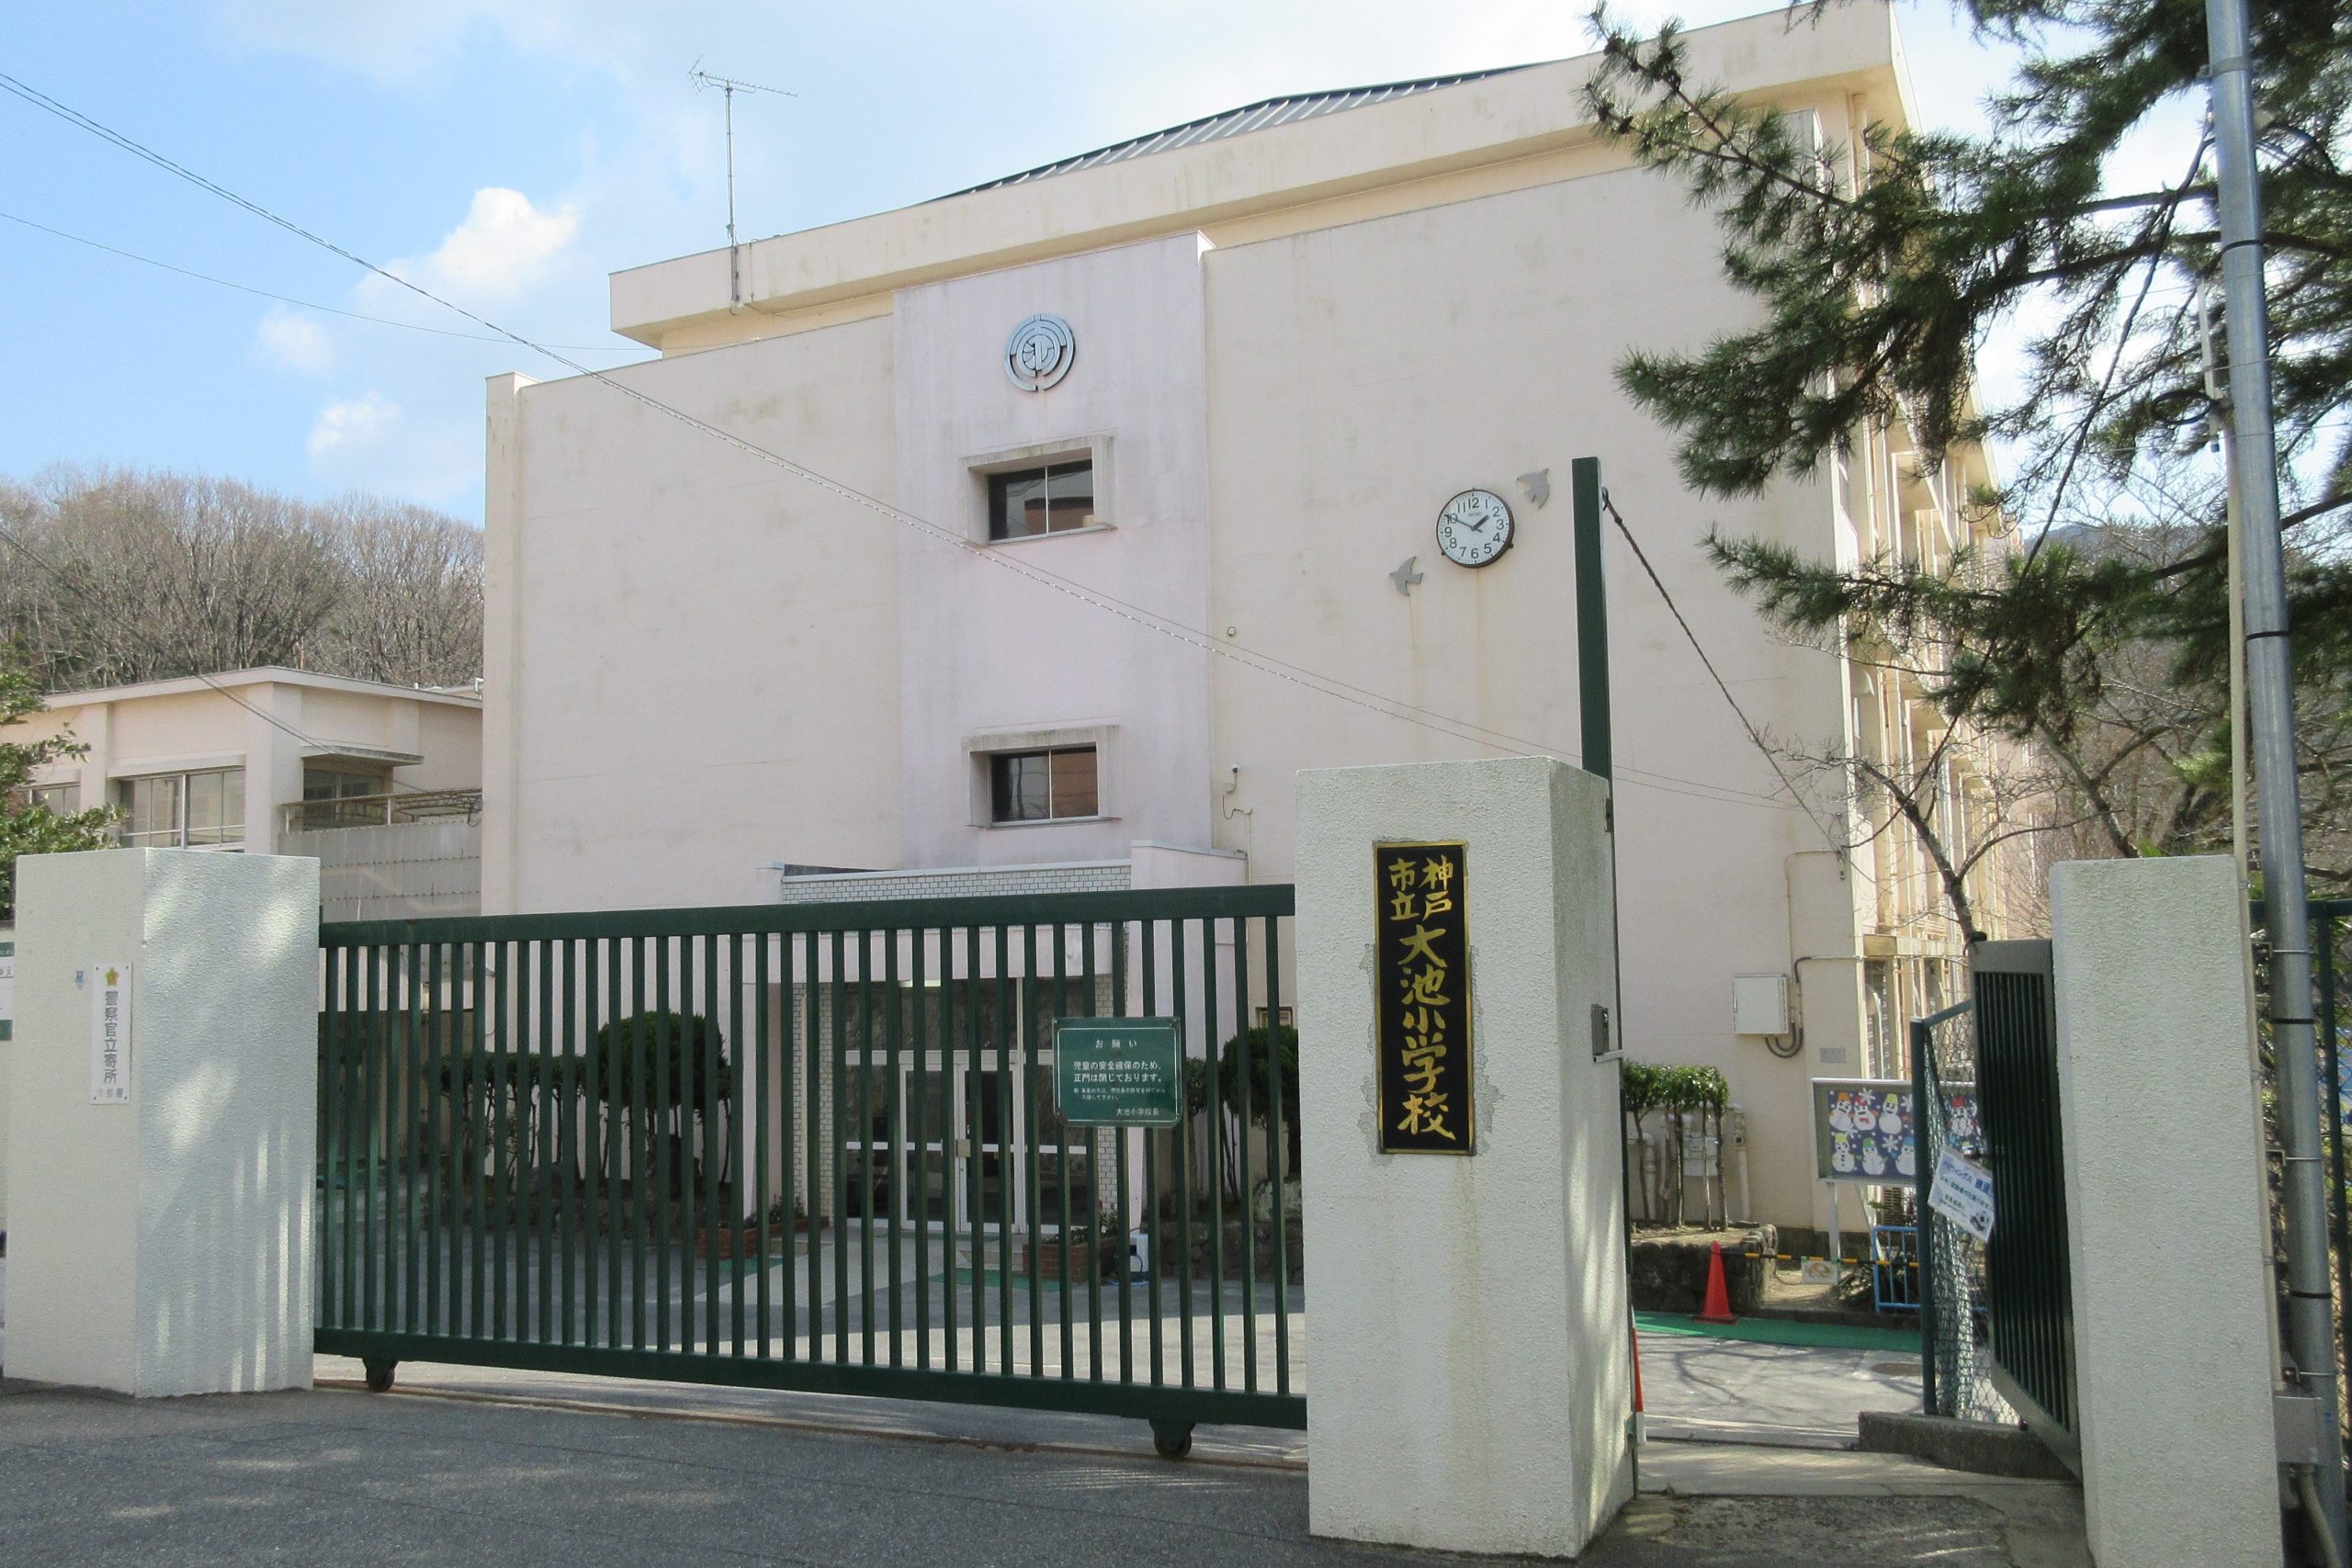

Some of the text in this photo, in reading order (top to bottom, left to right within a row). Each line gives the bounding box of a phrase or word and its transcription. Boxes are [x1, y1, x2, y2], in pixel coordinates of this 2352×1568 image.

[1457, 502, 1466, 513] 11
[1468, 497, 1479, 509] 12
[1492, 506, 1500, 517] 2
[1446, 513, 1458, 525] 10
[1496, 519, 1505, 530] 3
[1444, 526, 1452, 537] 9
[1449, 537, 1457, 548] 8
[1492, 532, 1501, 543] 4
[1459, 547, 1467, 558] 7
[1471, 547, 1479, 558] 6
[1484, 543, 1492, 554] 5
[1388, 857, 1419, 921] 市立
[1419, 854, 1454, 921] 神戸
[104, 990, 119, 1084] 警察官立寄所
[1397, 924, 1456, 1140] 大池小学校
[1095, 1039, 1137, 1049] お願い
[1073, 1073, 1162, 1083] 正門は閉じております。
[1116, 1107, 1159, 1116] 大池小学校長
